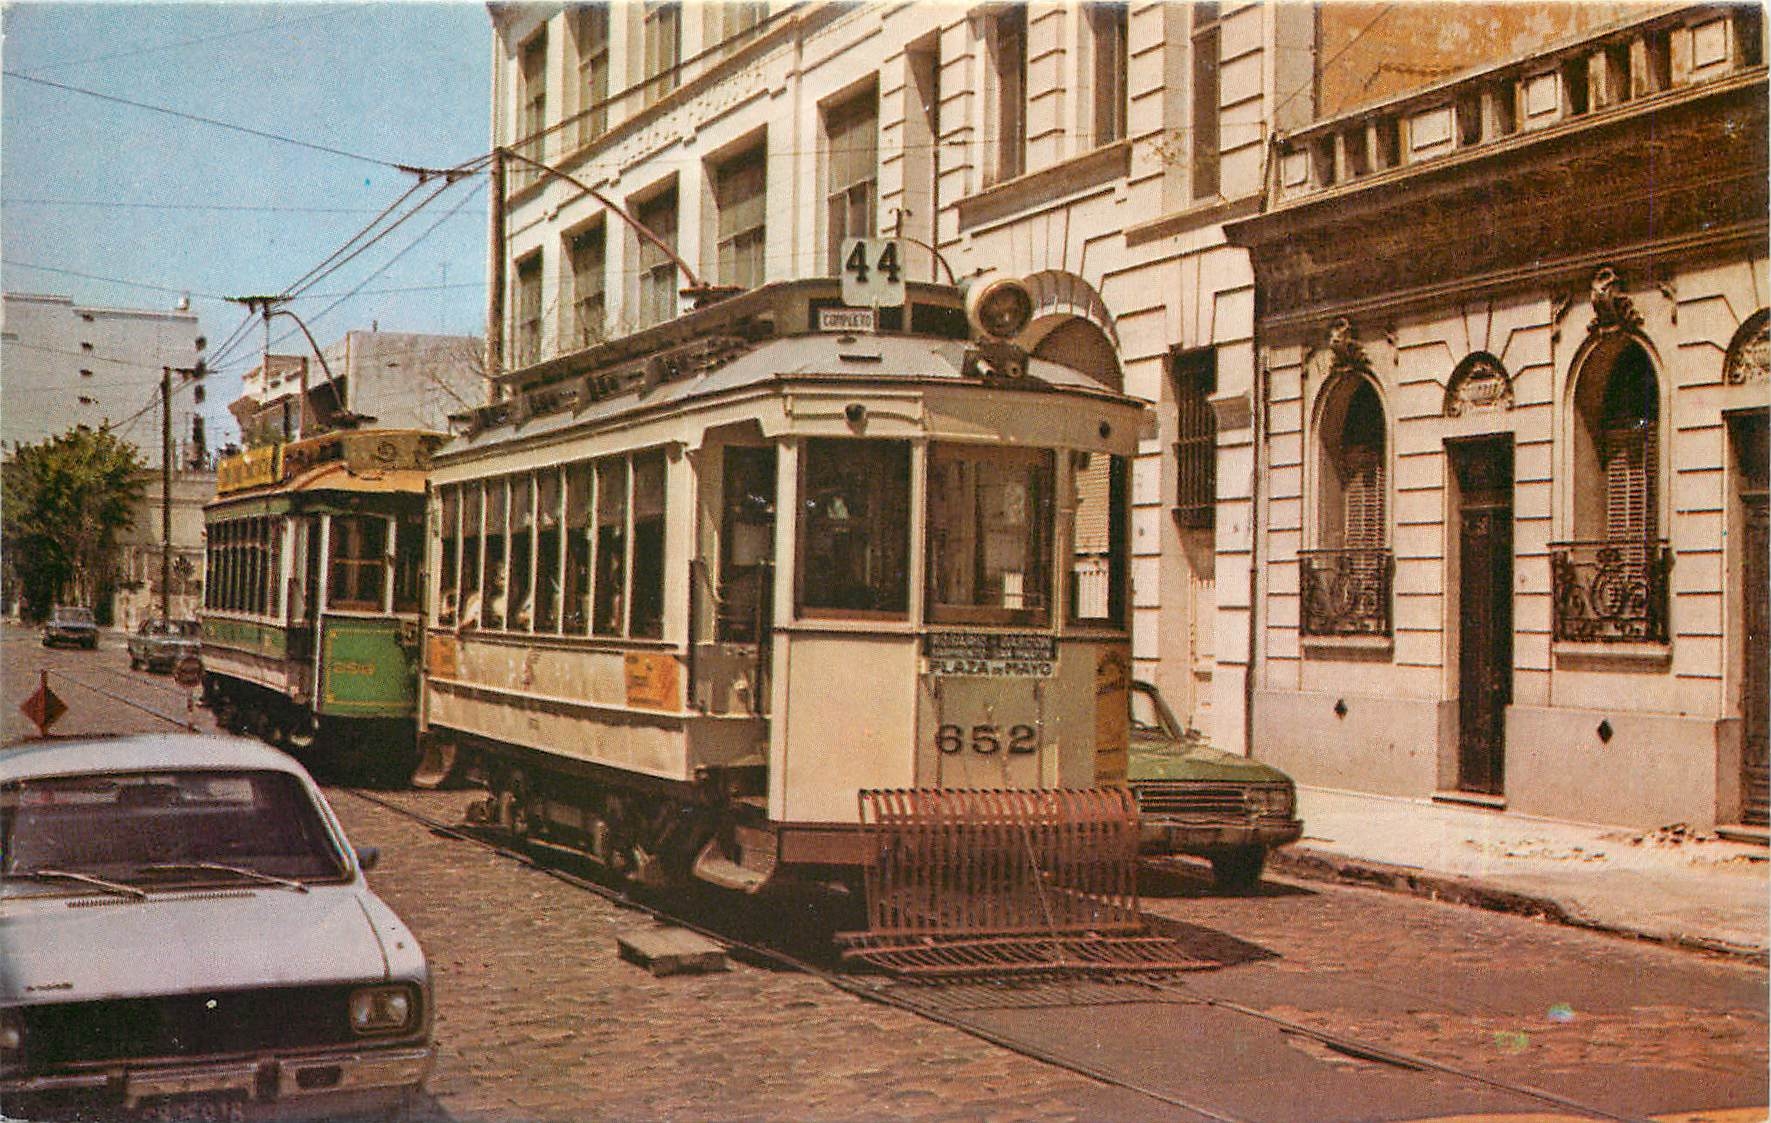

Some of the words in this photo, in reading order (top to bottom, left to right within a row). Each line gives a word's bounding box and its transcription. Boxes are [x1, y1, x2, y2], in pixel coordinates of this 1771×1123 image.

[846, 240, 901, 283] 44
[824, 314, 872, 327] COMPLETO
[929, 660, 989, 674] PLAZA
[1004, 661, 1052, 676] MAYO
[936, 724, 1036, 753] 652
